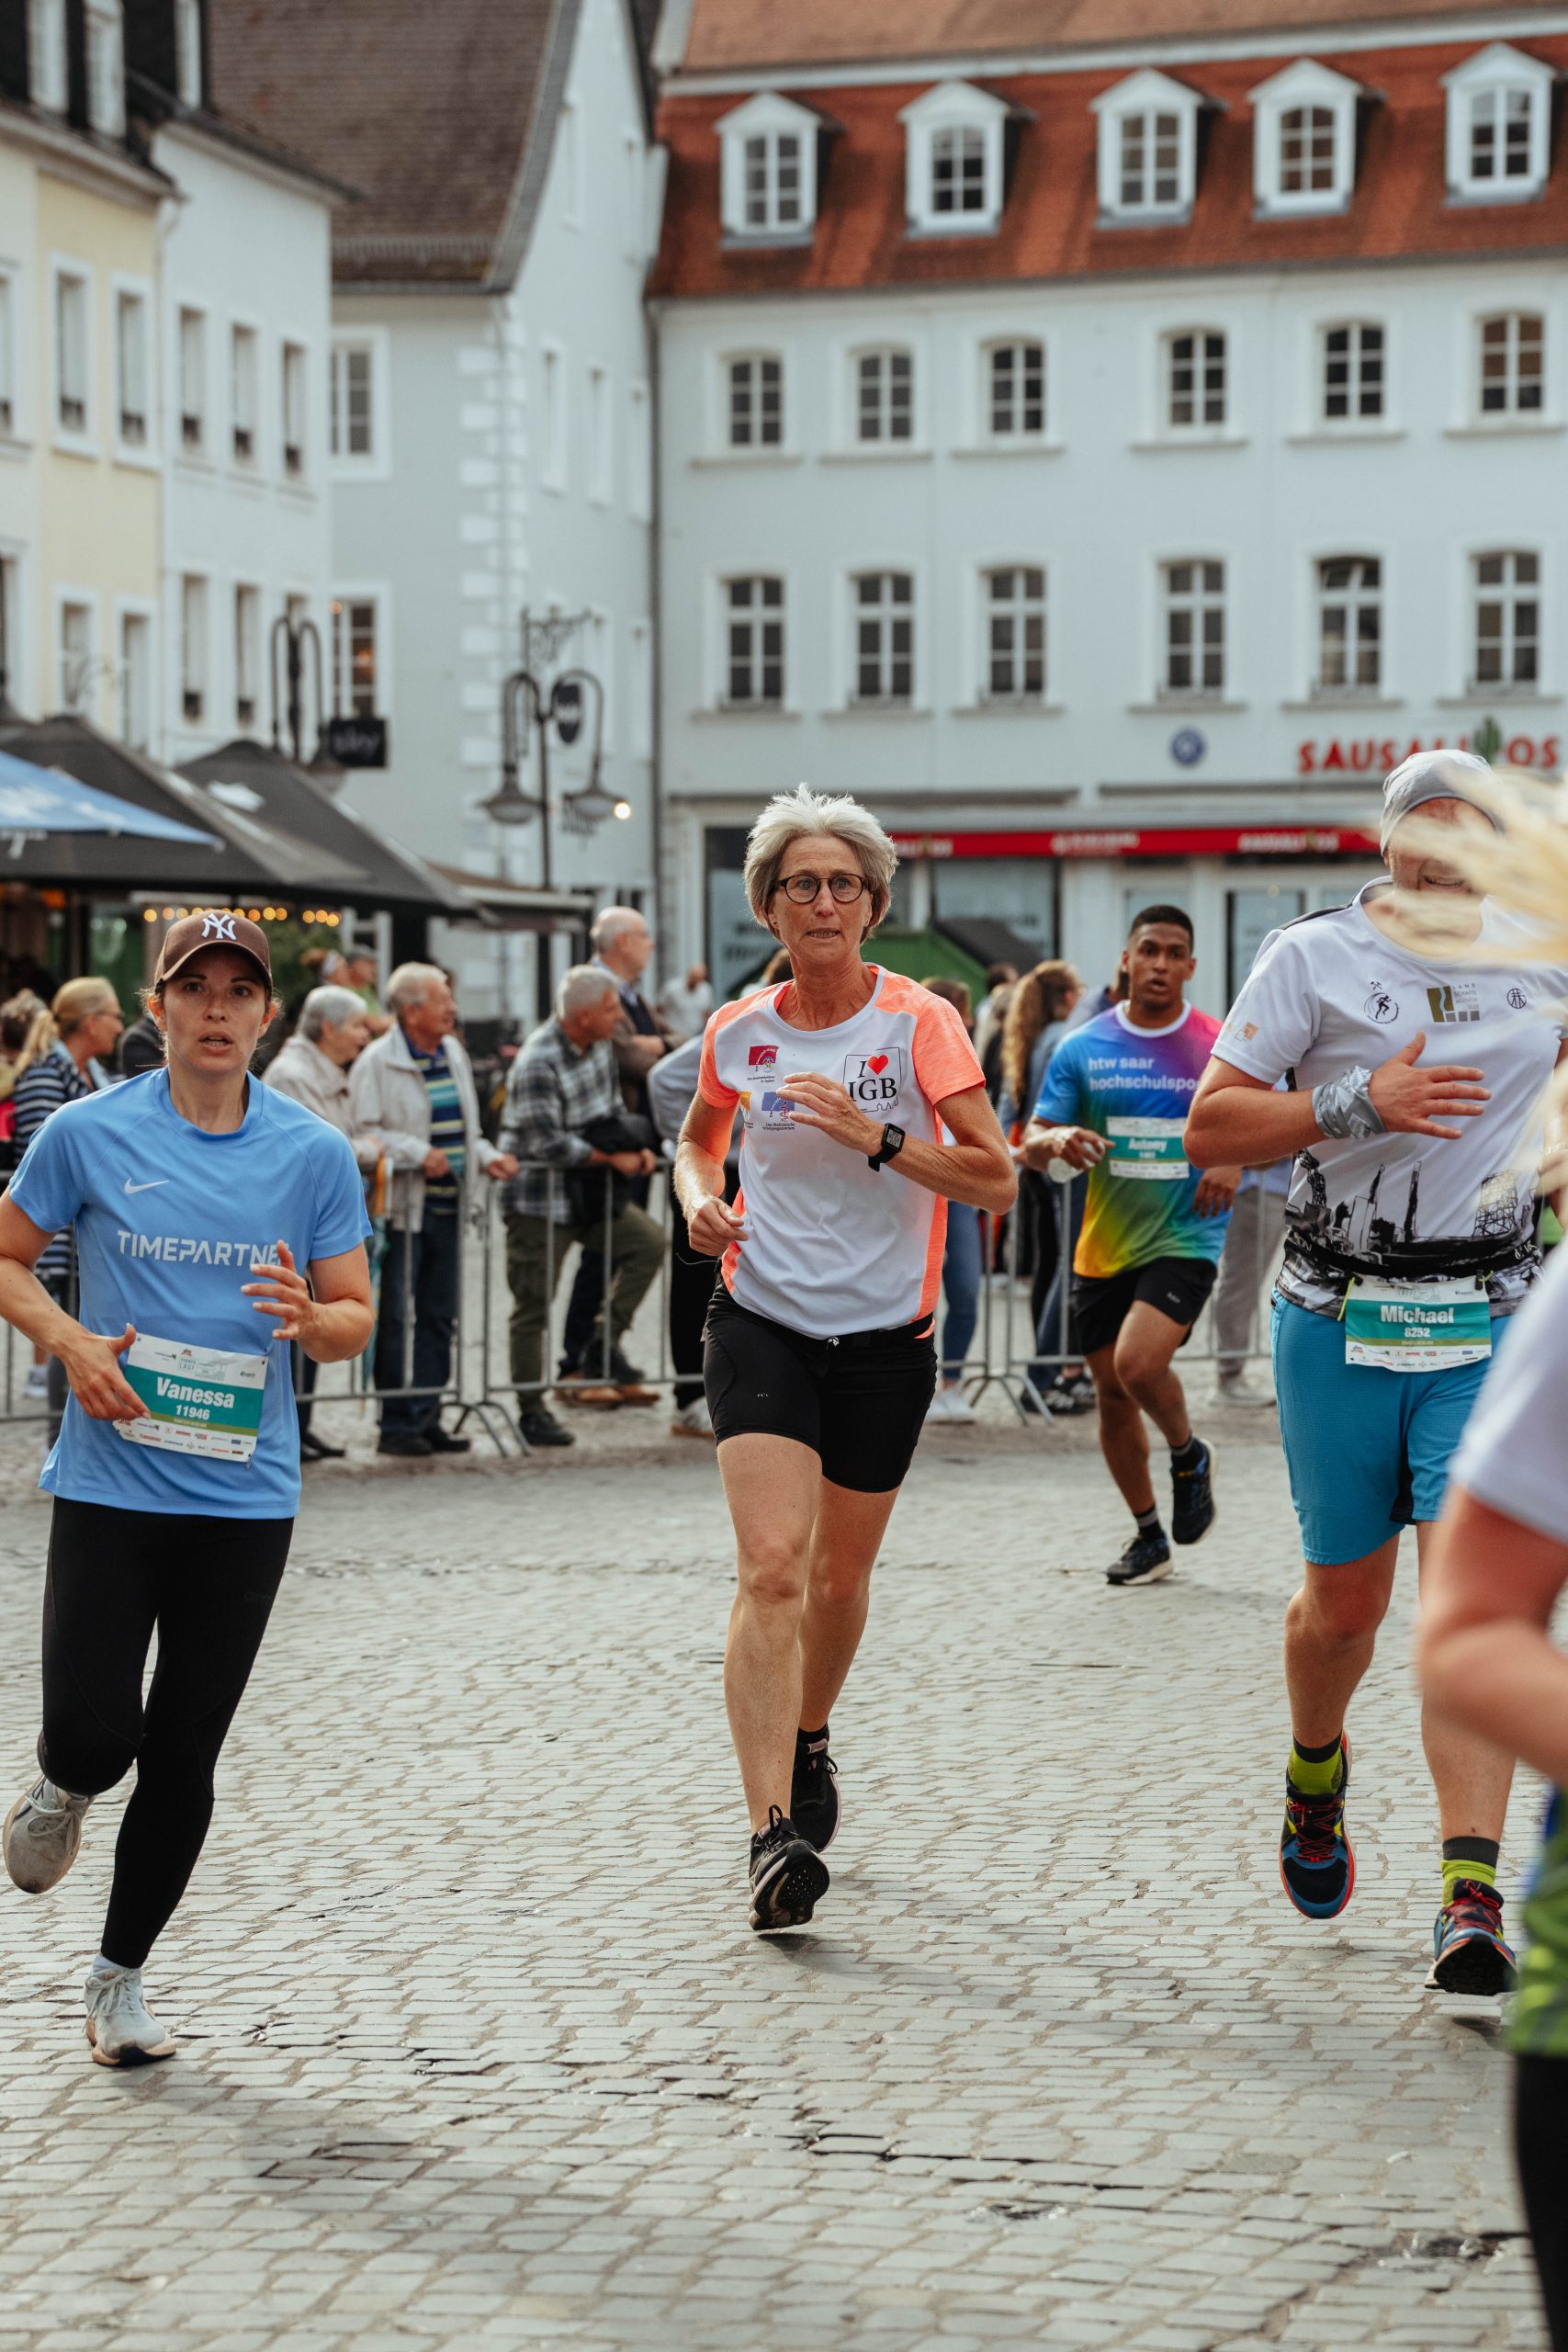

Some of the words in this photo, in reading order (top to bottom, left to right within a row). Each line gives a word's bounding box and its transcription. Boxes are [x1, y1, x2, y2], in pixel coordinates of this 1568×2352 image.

[1298, 735, 1560, 773] SAUSAOS
[857, 1060, 868, 1079] I
[1088, 1057, 1116, 1071] htw
[1119, 1057, 1155, 1070] saar
[848, 1078, 897, 1102] IGB
[1089, 1074, 1200, 1092] hochschulspo
[117, 1229, 289, 1267] TIMEPARTNE
[1381, 1305, 1454, 1324] Michael
[1404, 1327, 1430, 1338] 8252
[157, 1376, 235, 1409] Vanessa
[175, 1404, 211, 1421] 11946
